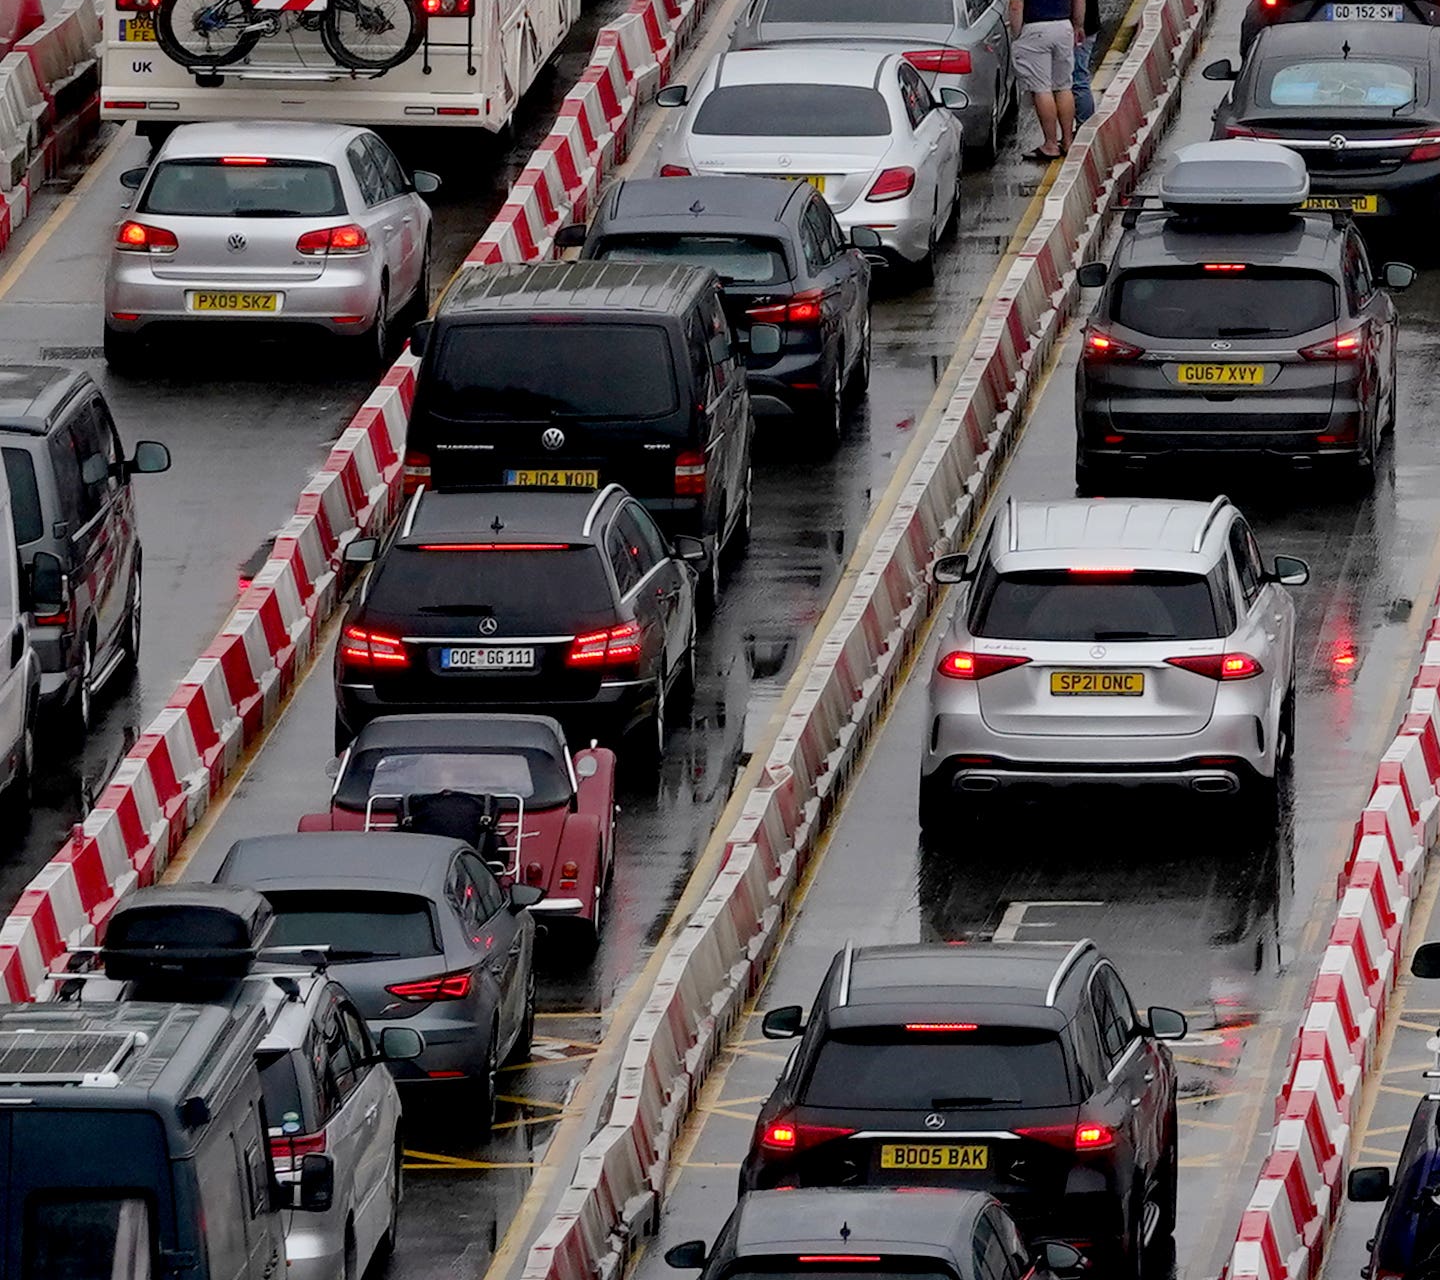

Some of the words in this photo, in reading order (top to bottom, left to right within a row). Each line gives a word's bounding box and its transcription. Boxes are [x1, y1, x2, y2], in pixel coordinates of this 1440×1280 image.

[133, 62, 152, 73] UK
[198, 295, 237, 310] PX09
[240, 295, 273, 310] SKZ
[1185, 367, 1222, 381] GU67
[1228, 367, 1258, 381] XVY
[450, 651, 477, 666] COE
[486, 651, 506, 665] GG
[507, 651, 533, 665] 111
[1061, 675, 1098, 690] SP21
[1102, 675, 1134, 690] ONC
